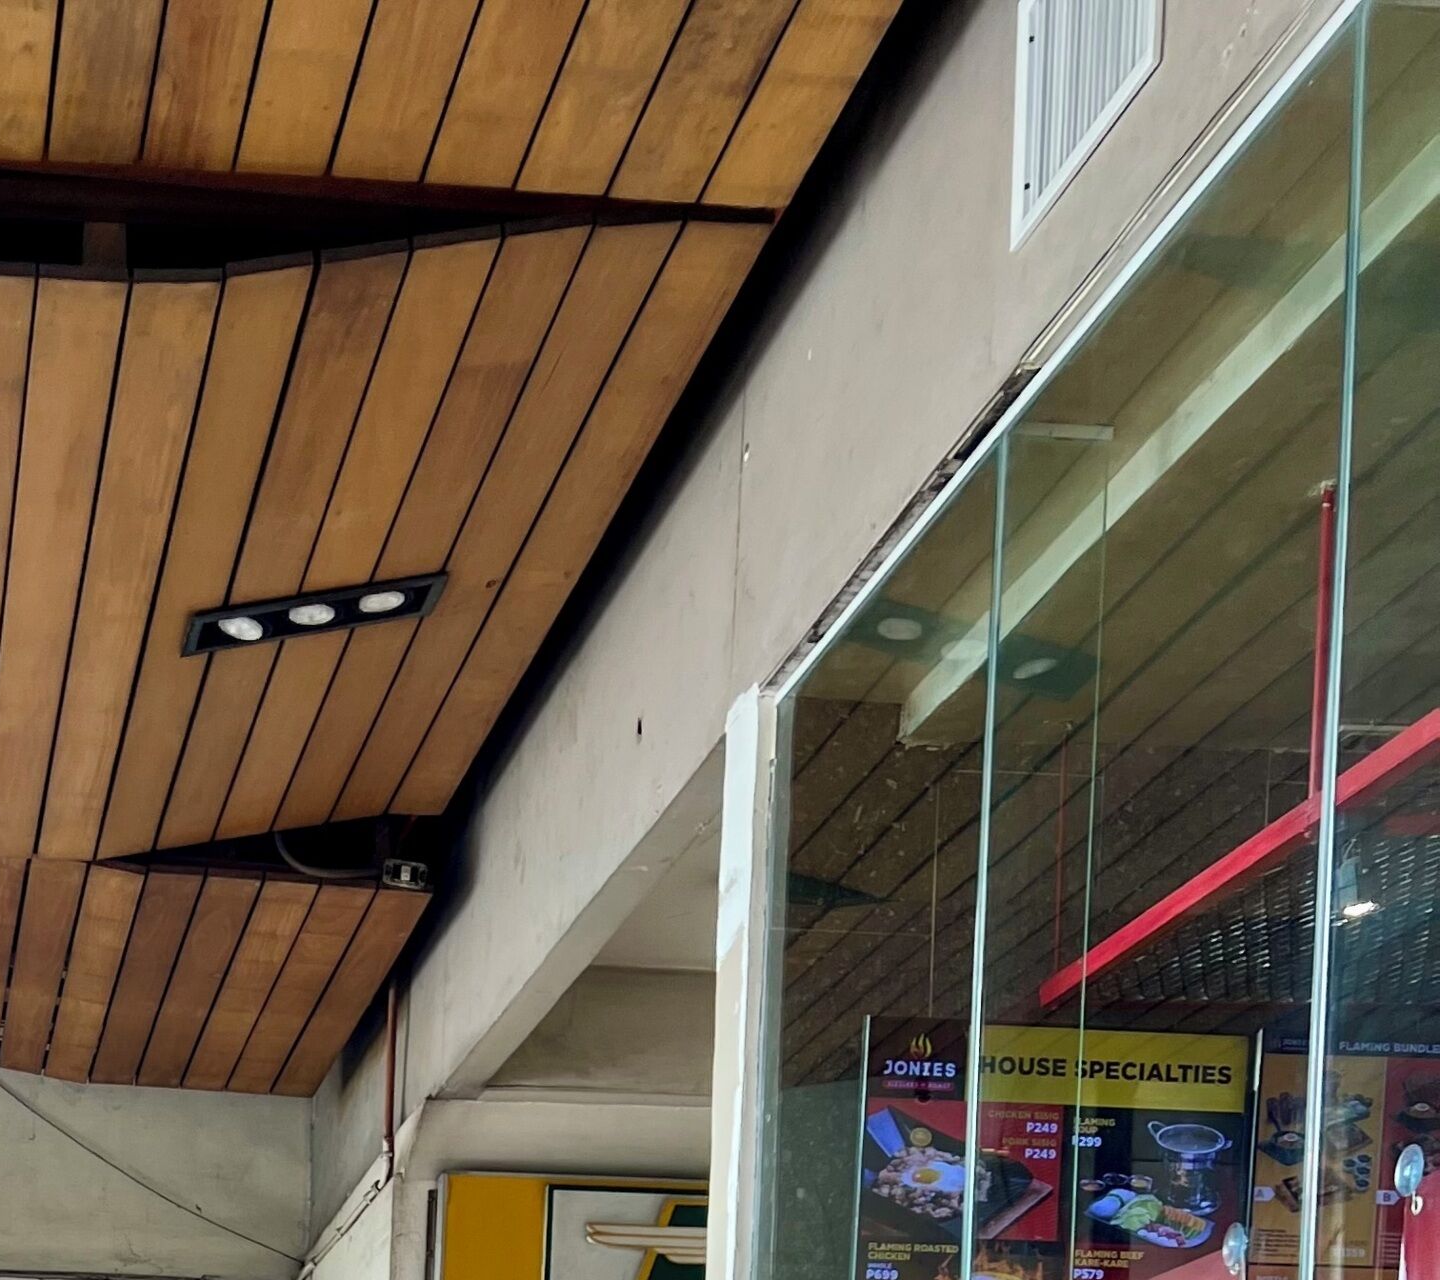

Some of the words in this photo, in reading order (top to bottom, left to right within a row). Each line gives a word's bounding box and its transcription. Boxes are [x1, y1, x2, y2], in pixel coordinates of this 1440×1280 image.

[1339, 1041, 1391, 1052] FLAMING
[884, 1060, 956, 1077] JONIES
[981, 1056, 1067, 1077] HOUSE
[1074, 1059, 1233, 1085] SPECIALTIES
[1026, 1122, 1058, 1133] P249
[1025, 1148, 1057, 1159] P249
[868, 1242, 912, 1252] FLAMING
[914, 1244, 959, 1254] ROASTED
[867, 1251, 911, 1260] CHICKEN
[1075, 1249, 1118, 1259] FLAMING
[1075, 1258, 1129, 1268] KARE-KARE
[866, 1269, 899, 1280] P699
[1073, 1268, 1104, 1280] P579
